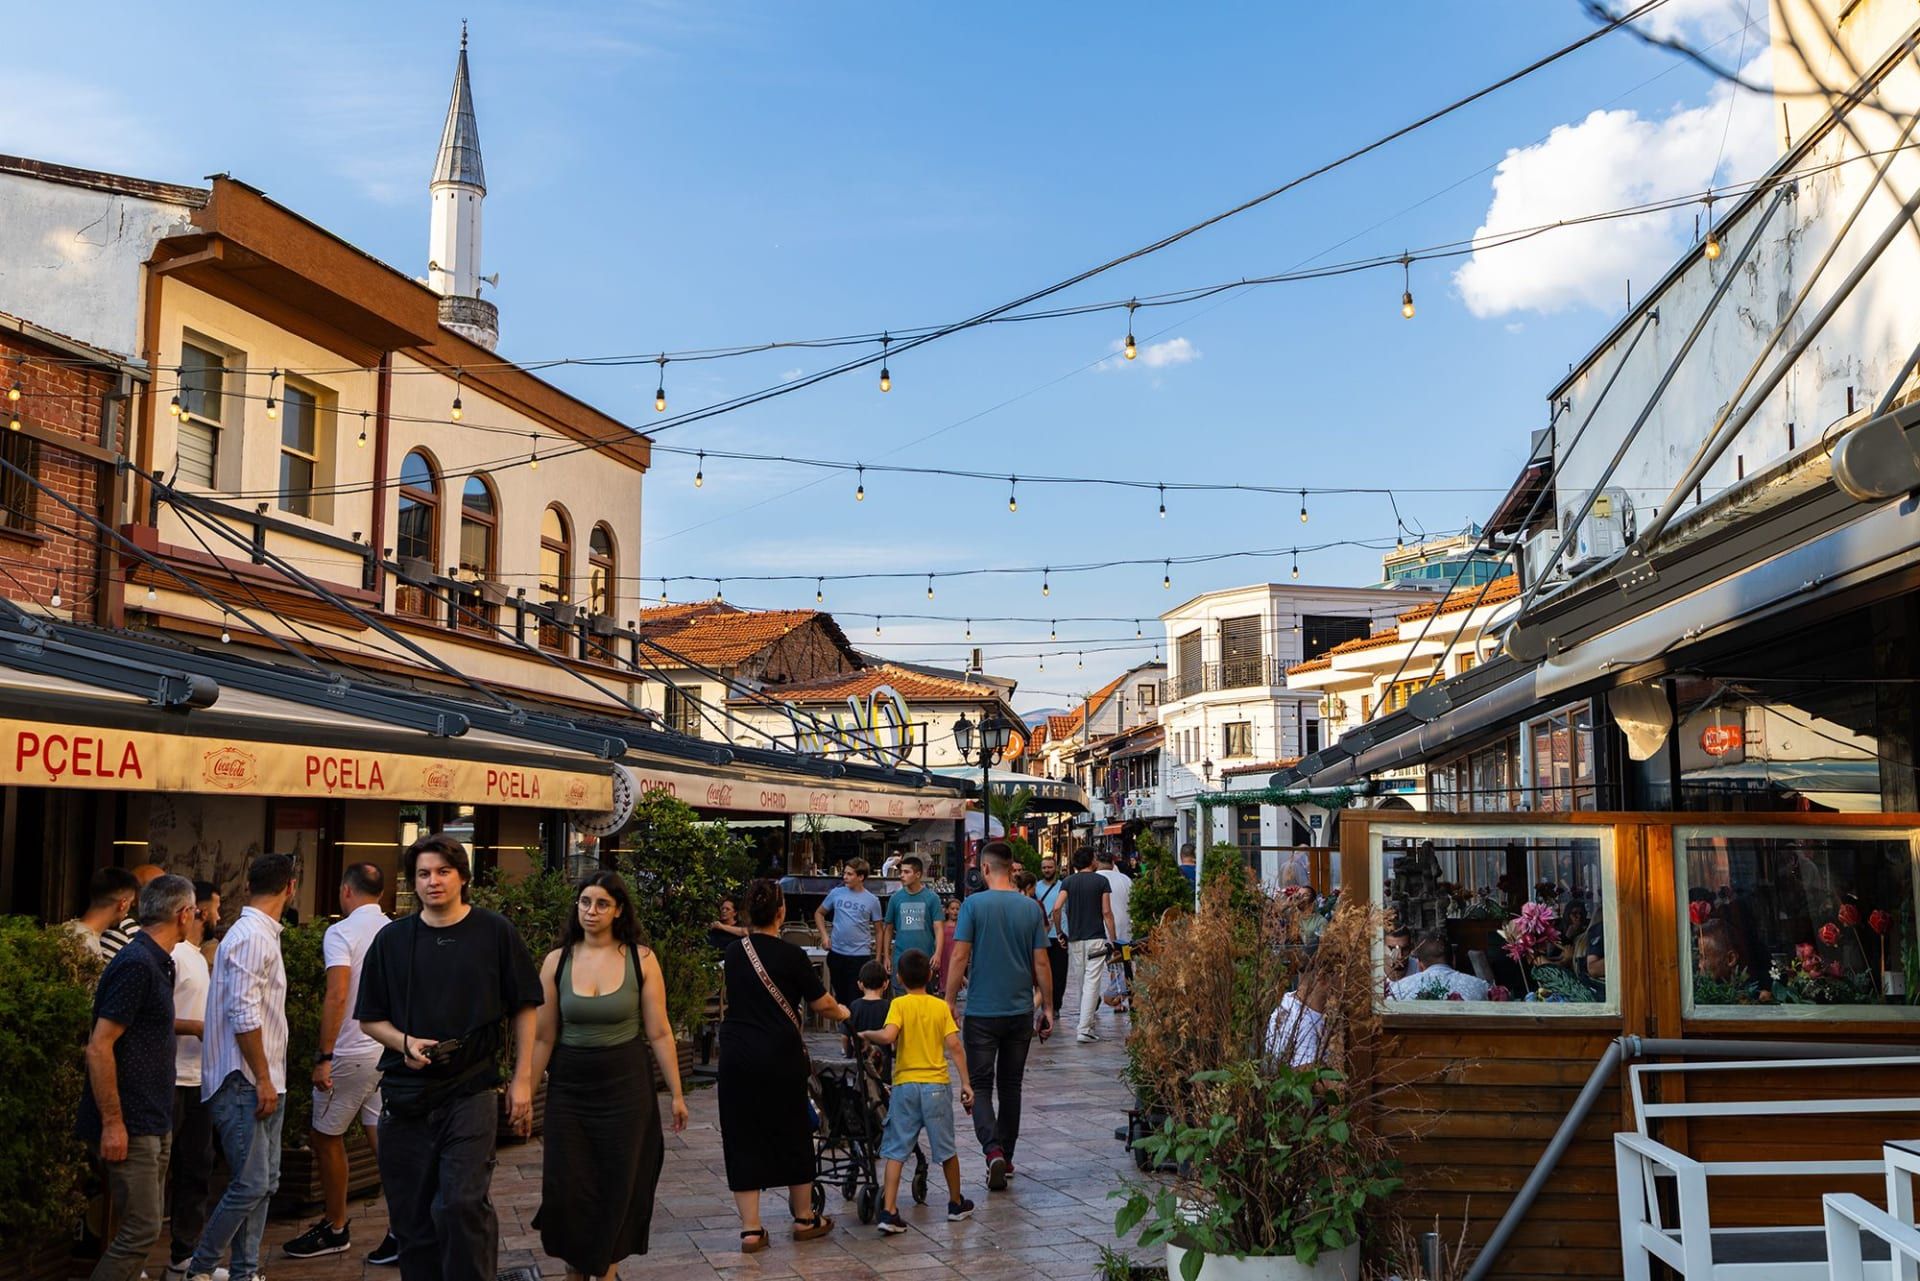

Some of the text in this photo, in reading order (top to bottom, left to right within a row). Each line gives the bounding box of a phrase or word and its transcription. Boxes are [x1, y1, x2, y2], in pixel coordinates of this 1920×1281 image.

[16, 731, 143, 782] PÇELA
[306, 755, 385, 793] PÇELA
[486, 769, 541, 801] PÇELA
[992, 783, 1067, 798] MARKET
[760, 791, 787, 809] OHRID
[849, 799, 870, 814] OHRID
[836, 899, 866, 912] BOSS
